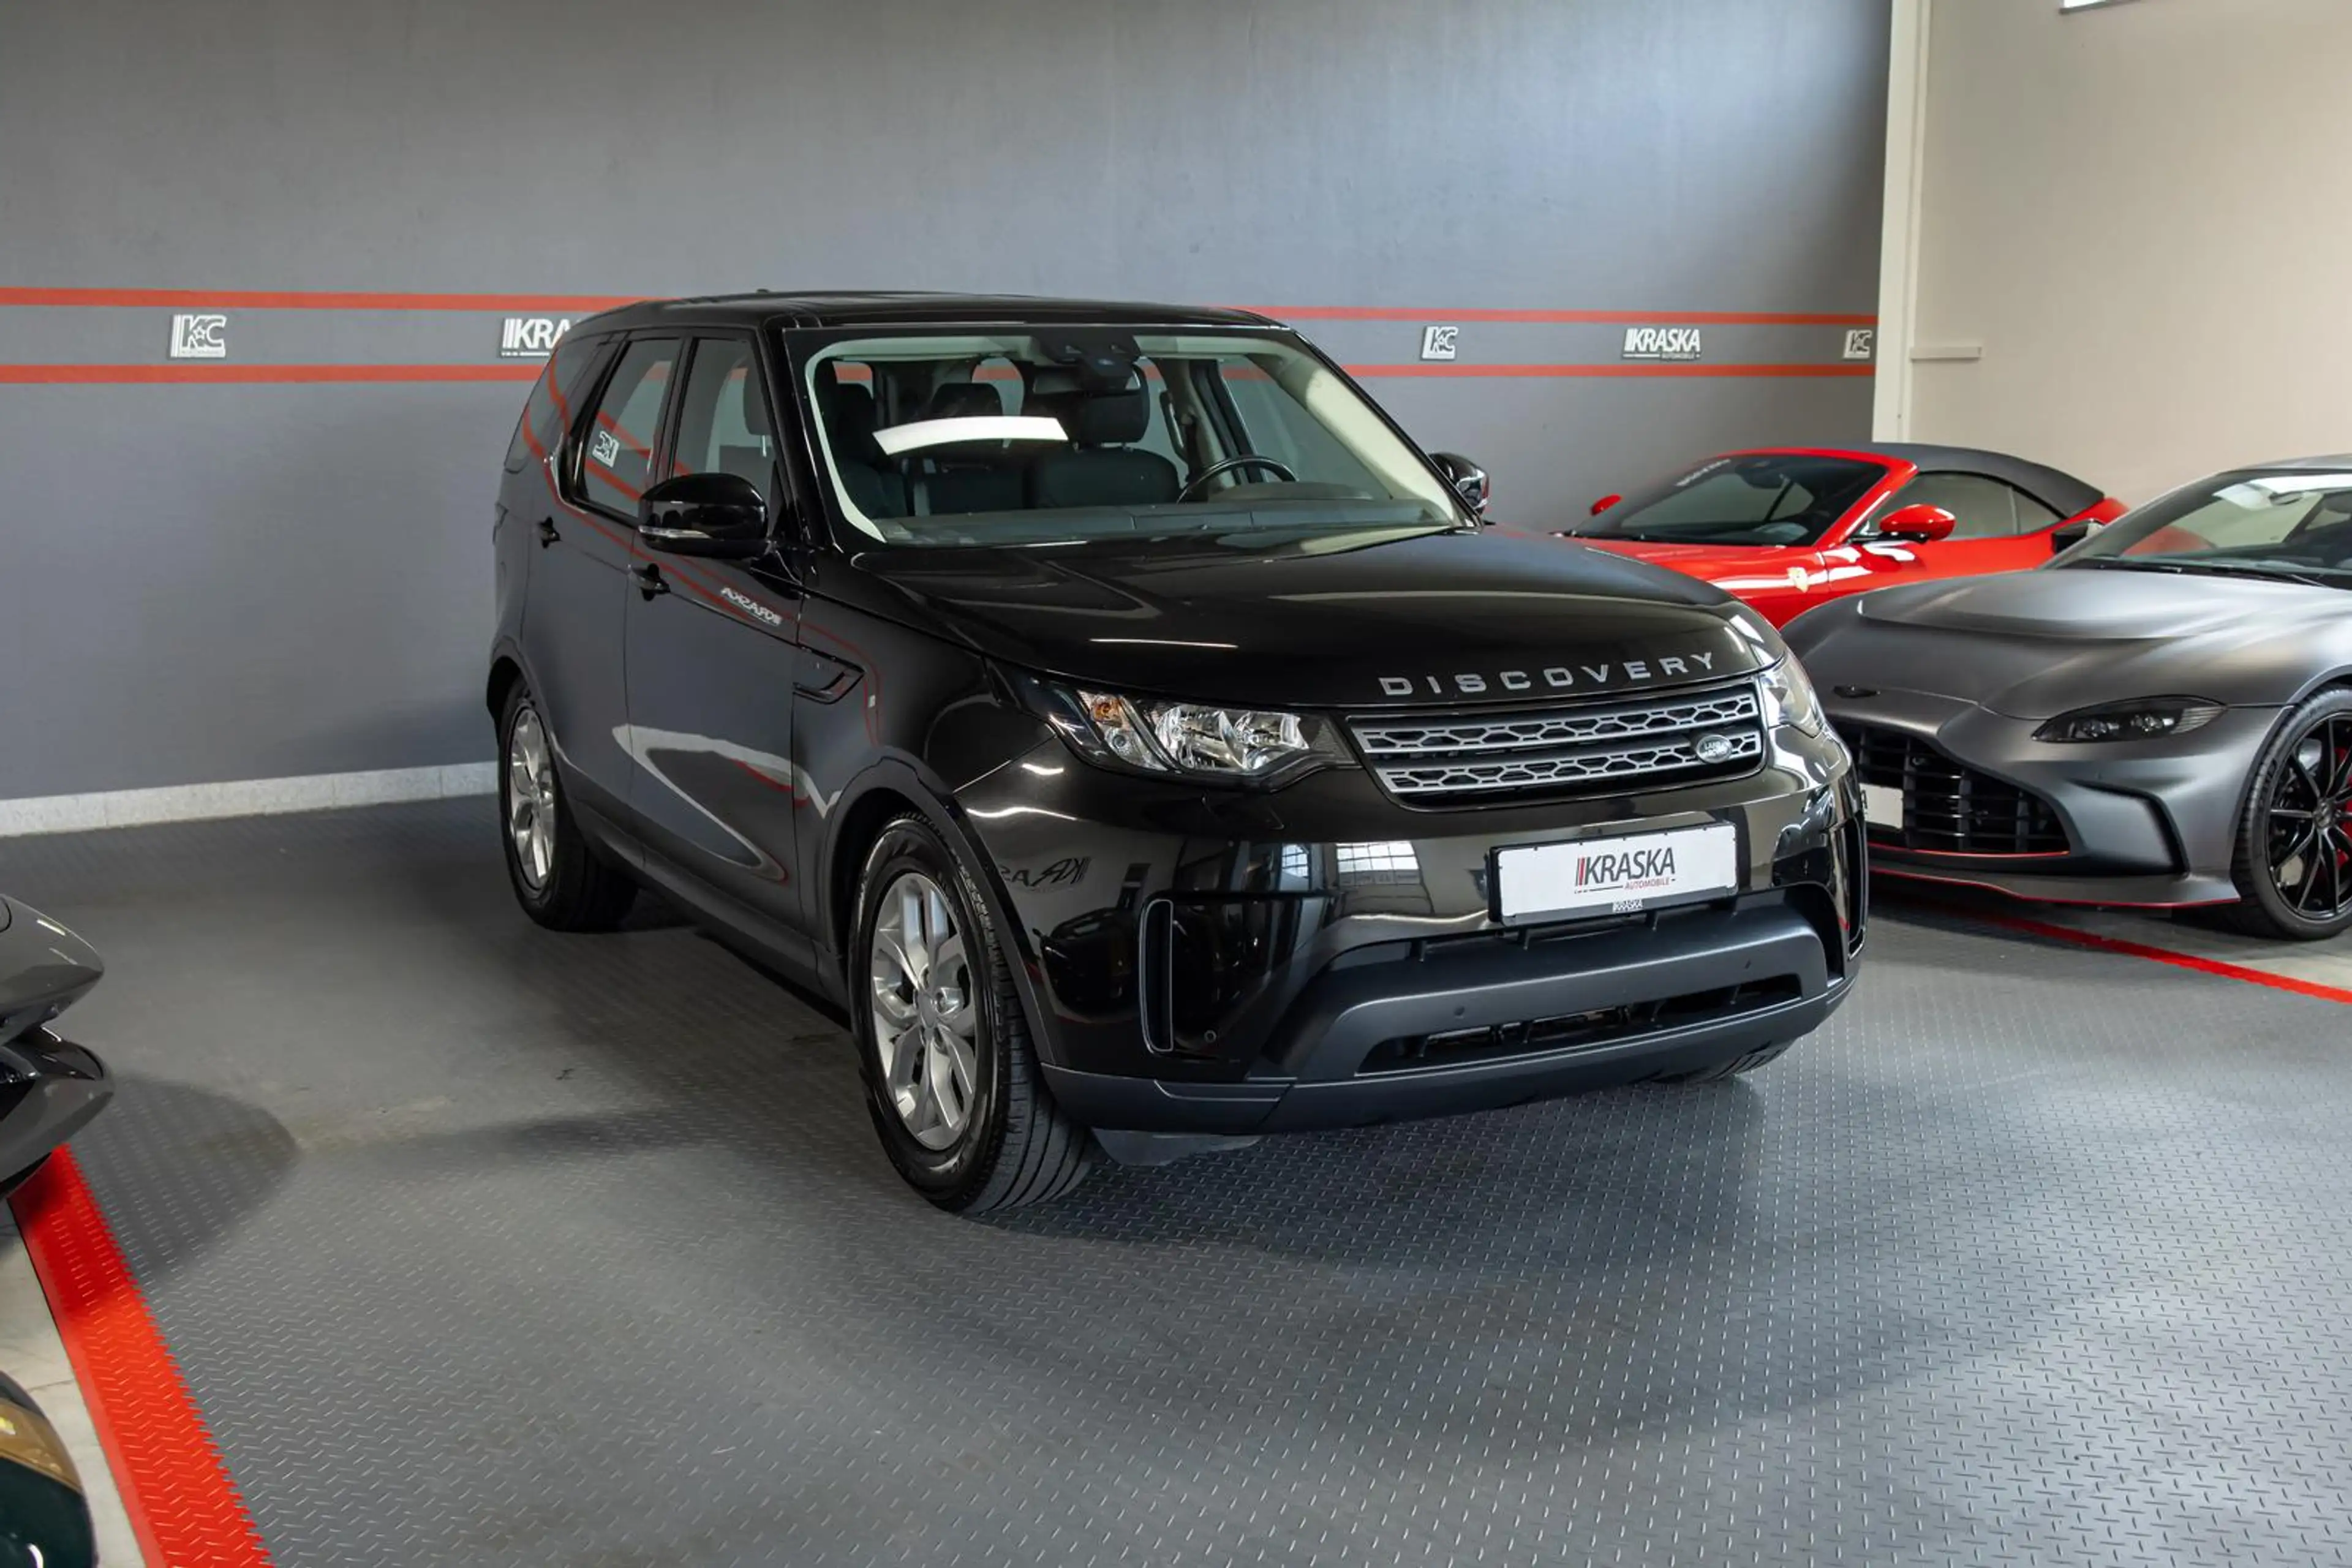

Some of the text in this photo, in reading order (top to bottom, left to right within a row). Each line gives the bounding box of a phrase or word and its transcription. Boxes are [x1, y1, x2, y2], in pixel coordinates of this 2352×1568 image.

[510, 318, 571, 349] KRA
[1629, 328, 1700, 352] KRASKA
[1378, 652, 1713, 696] DISCOVERY
[1582, 846, 1676, 885] KRASKA
[1624, 877, 1670, 890] AUTOMOBILE
